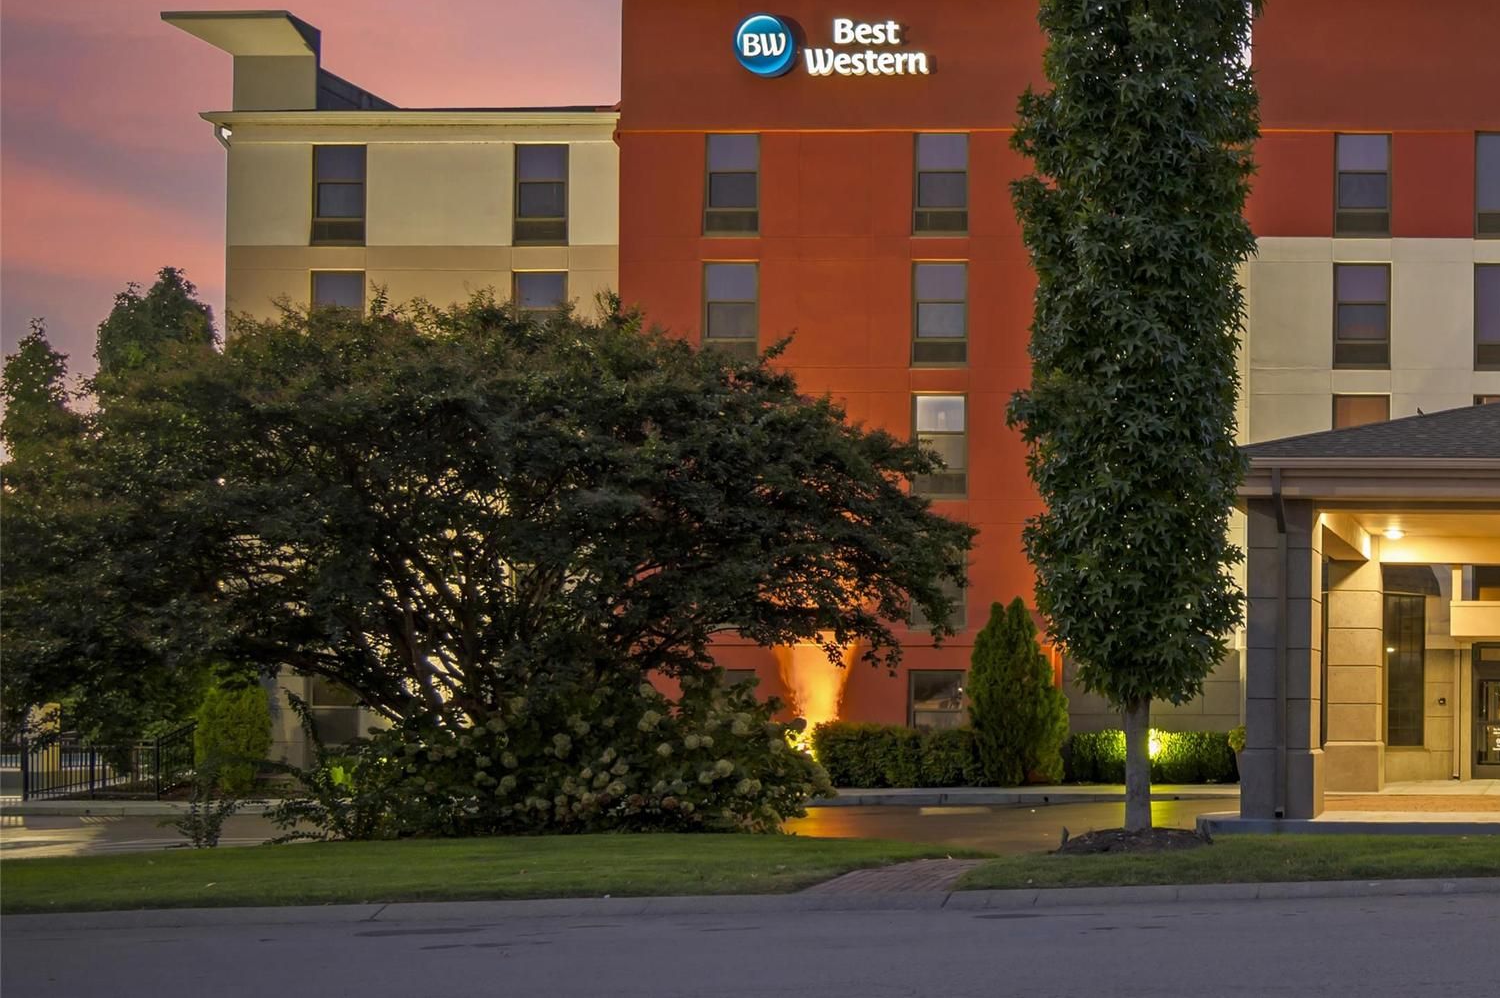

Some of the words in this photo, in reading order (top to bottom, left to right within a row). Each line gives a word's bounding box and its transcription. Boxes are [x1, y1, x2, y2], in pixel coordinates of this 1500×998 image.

[742, 32, 786, 56] BW
[833, 18, 900, 44] Best
[804, 48, 929, 76] Western
